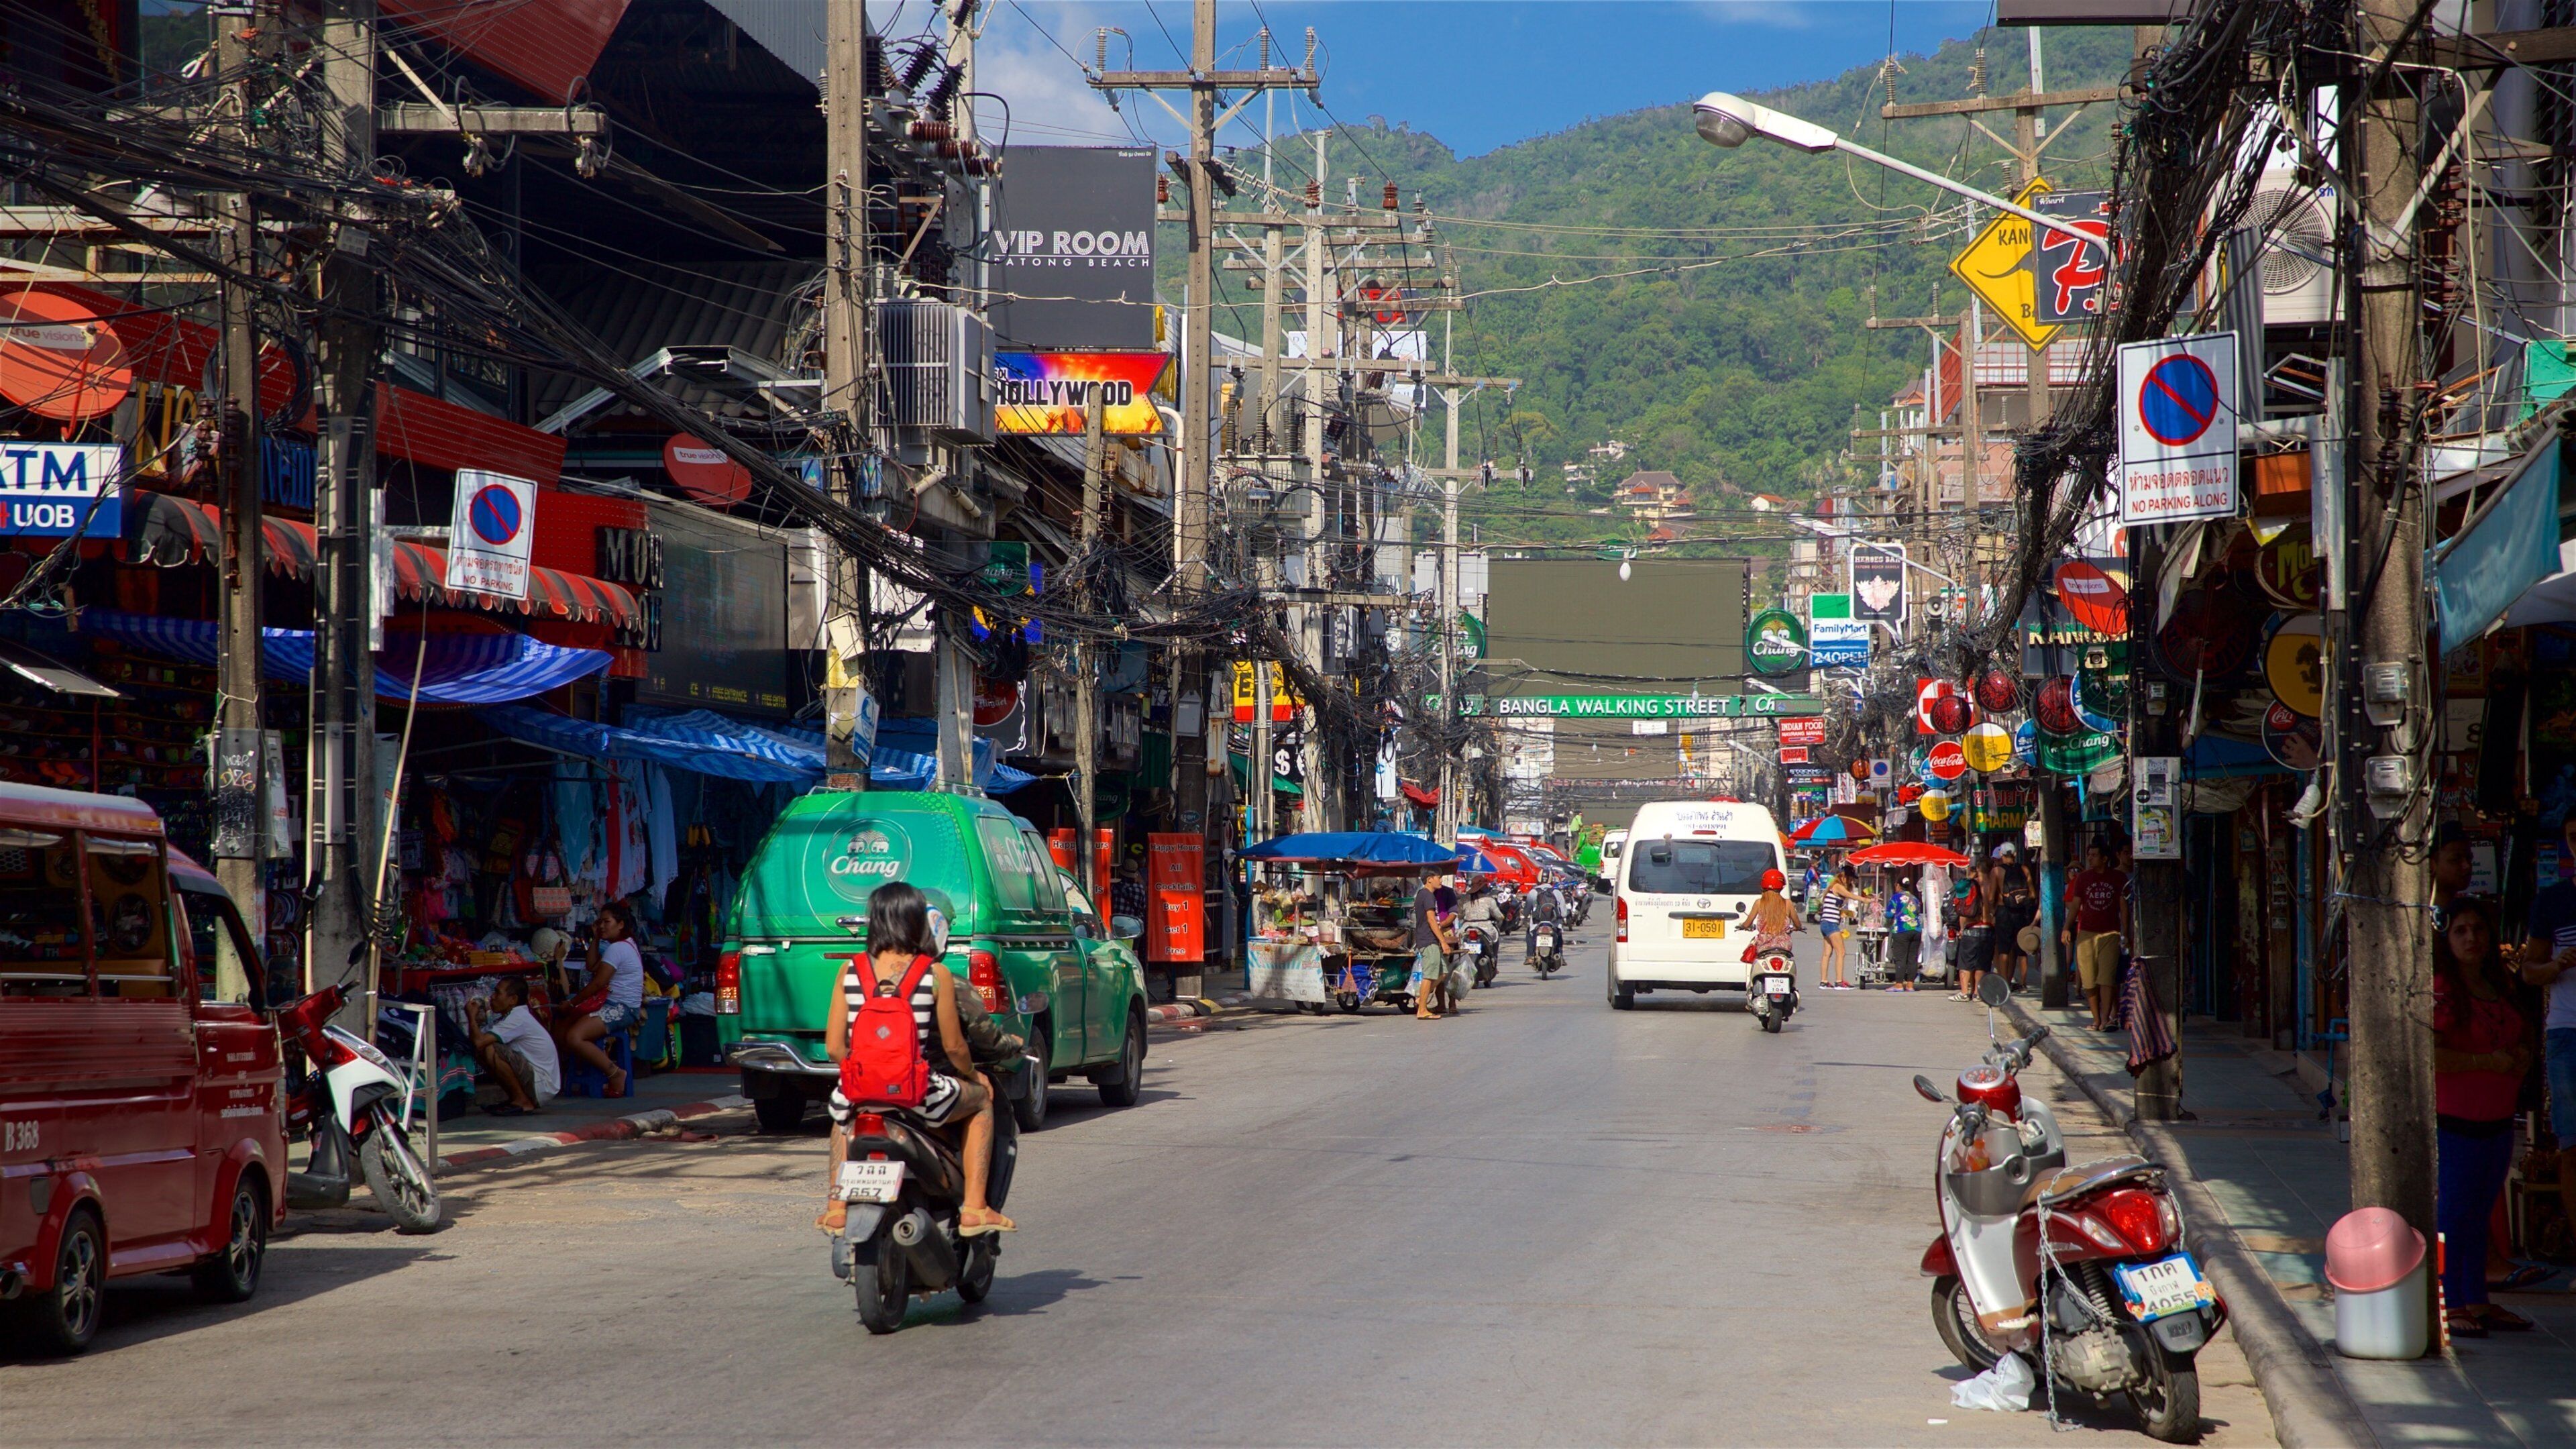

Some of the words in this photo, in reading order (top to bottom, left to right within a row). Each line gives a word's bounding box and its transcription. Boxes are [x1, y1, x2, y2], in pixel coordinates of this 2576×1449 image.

[994, 230, 1044, 254] VIP
[1053, 231, 1150, 256] ROOM
[1088, 259, 1150, 267] BEACH
[995, 380, 1132, 406] HOLLYWOOD
[680, 450, 698, 460] true
[2129, 467, 2229, 492] ห้ามจอดตลอดแนว
[2132, 500, 2146, 513] NO
[2148, 495, 2191, 511] PARKING
[2192, 492, 2228, 508] ALONG
[13, 504, 75, 529] UOB
[464, 574, 477, 585] NO
[480, 576, 514, 592] PARKING
[1814, 623, 1867, 635] FamilyMart
[1499, 699, 1570, 714] BANGLA
[1576, 699, 1658, 714] WALKING
[1665, 698, 1730, 714] STREET
[1781, 722, 1803, 731] INDIAN
[1805, 721, 1823, 730] FOOD
[2069, 735, 2109, 749] Chang
[1094, 794, 1119, 804] hang
[1975, 812, 2027, 829] PHARMA
[1052, 839, 1076, 850] Happ
[1150, 843, 1175, 853] Happy
[1177, 843, 1201, 851] Hours
[830, 855, 900, 878] Chang
[1169, 863, 1182, 872] All
[1155, 882, 1196, 891] Cocktails
[2088, 892, 2112, 900] AERO
[1163, 903, 1180, 912] Buy
[1183, 901, 1189, 910] 1
[1182, 924, 1188, 933] 1
[1685, 922, 1721, 932] 31-0591
[1165, 947, 1186, 955] Free
[5, 1122, 15, 1152] B
[16, 1120, 40, 1150] 368
[849, 1187, 882, 1197] 657
[2147, 1290, 2198, 1313] 4055
